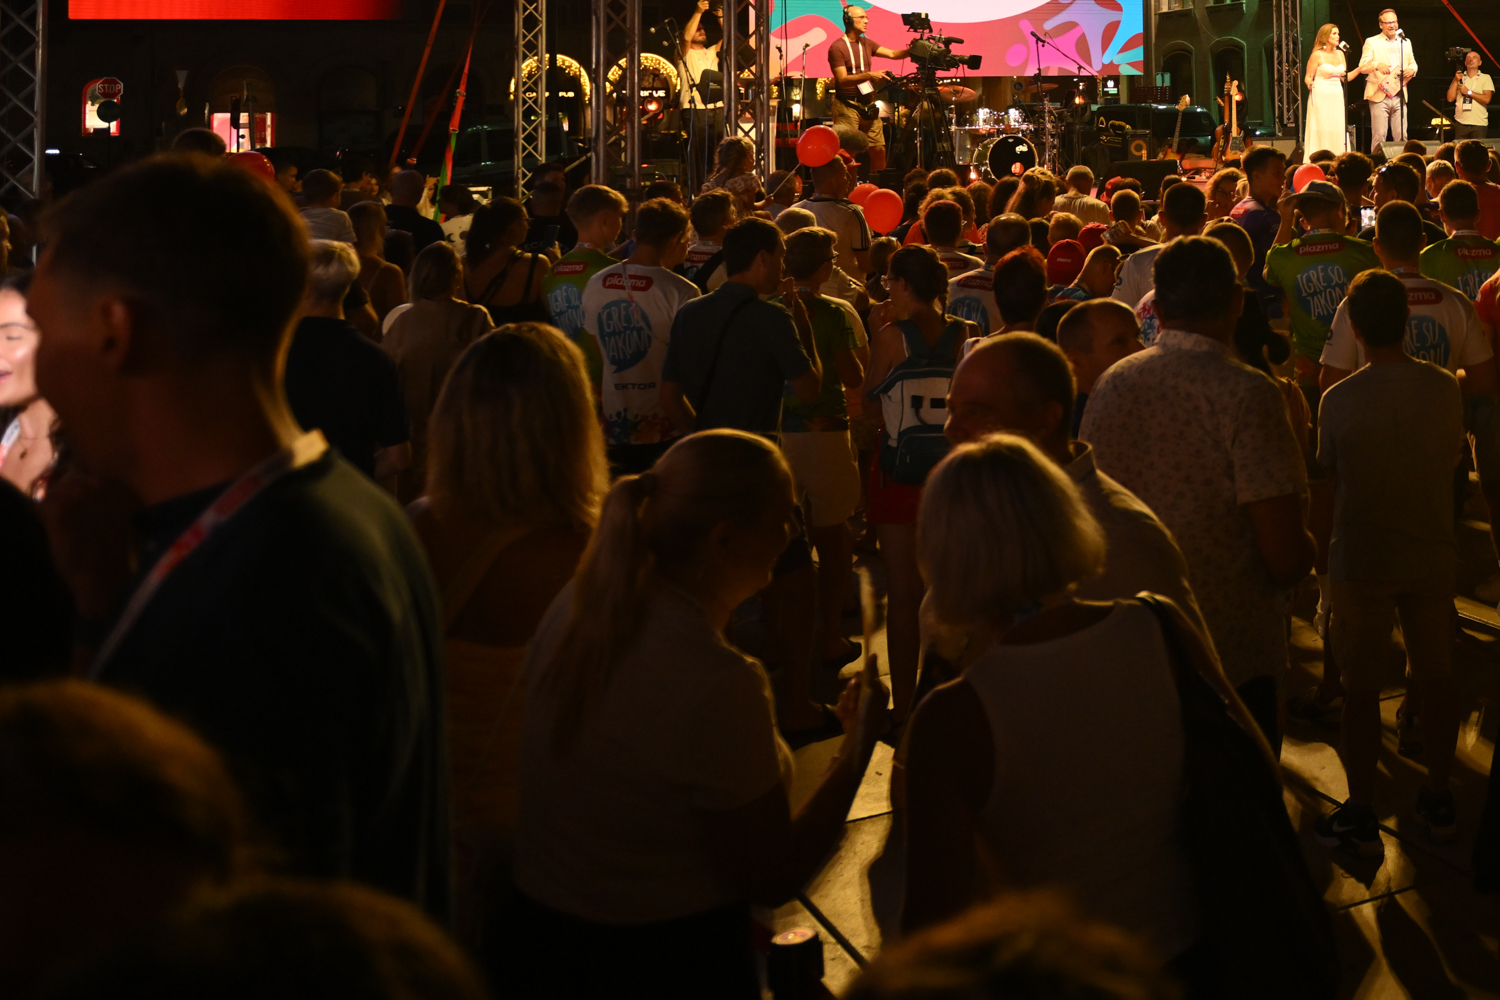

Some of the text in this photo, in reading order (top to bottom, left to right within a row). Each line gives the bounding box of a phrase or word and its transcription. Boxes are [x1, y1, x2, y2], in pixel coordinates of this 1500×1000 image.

[98, 84, 121, 94] STOP
[1298, 242, 1339, 255] plazma
[552, 262, 584, 275] plazma
[1296, 265, 1328, 297] IGRE
[1306, 285, 1348, 320] ZAKON
